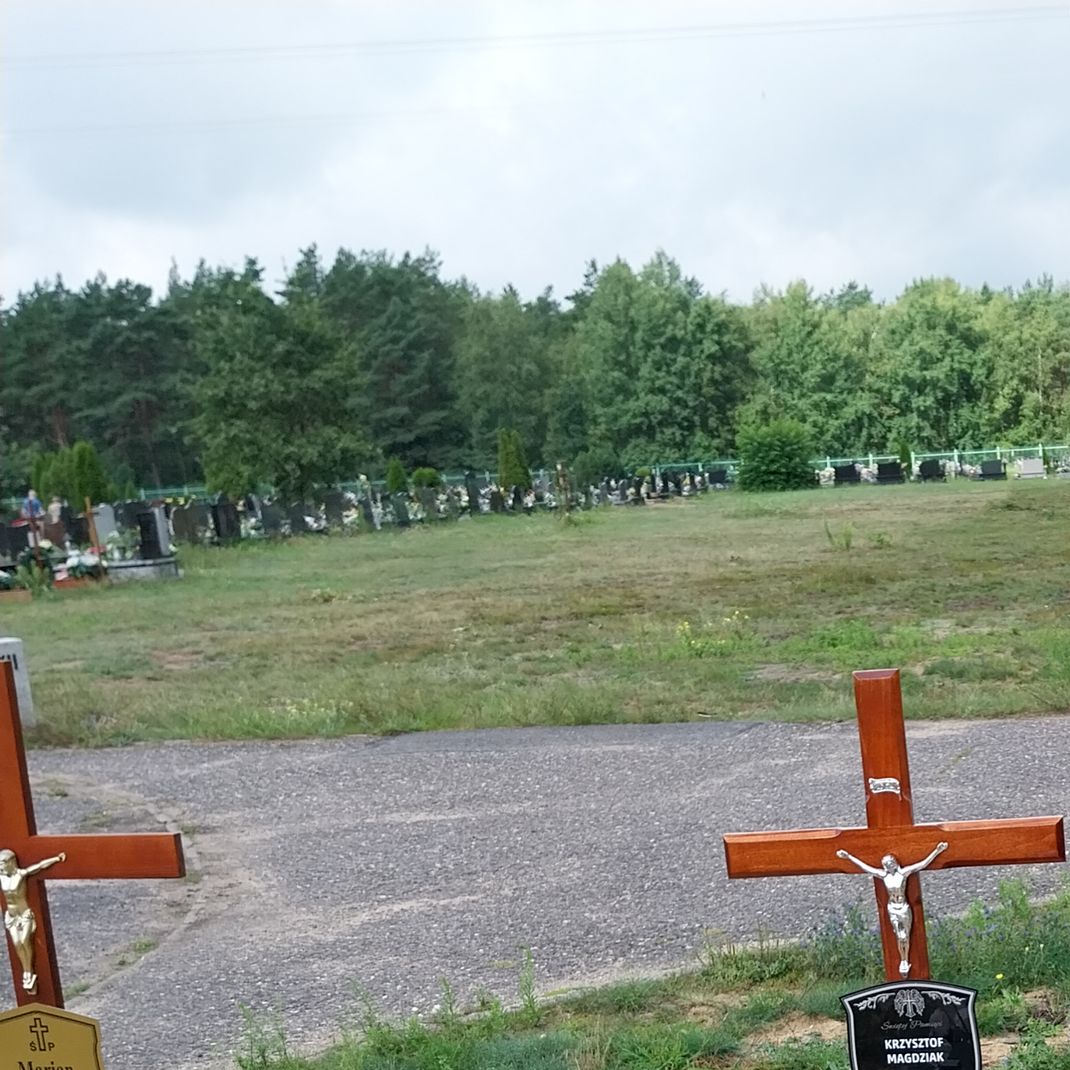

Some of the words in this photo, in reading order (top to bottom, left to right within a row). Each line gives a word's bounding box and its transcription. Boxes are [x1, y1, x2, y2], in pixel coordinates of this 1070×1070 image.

[47, 1042, 55, 1052] P
[884, 1037, 944, 1050] KRZYSZTOF
[887, 1052, 945, 1064] MAGDZIAK
